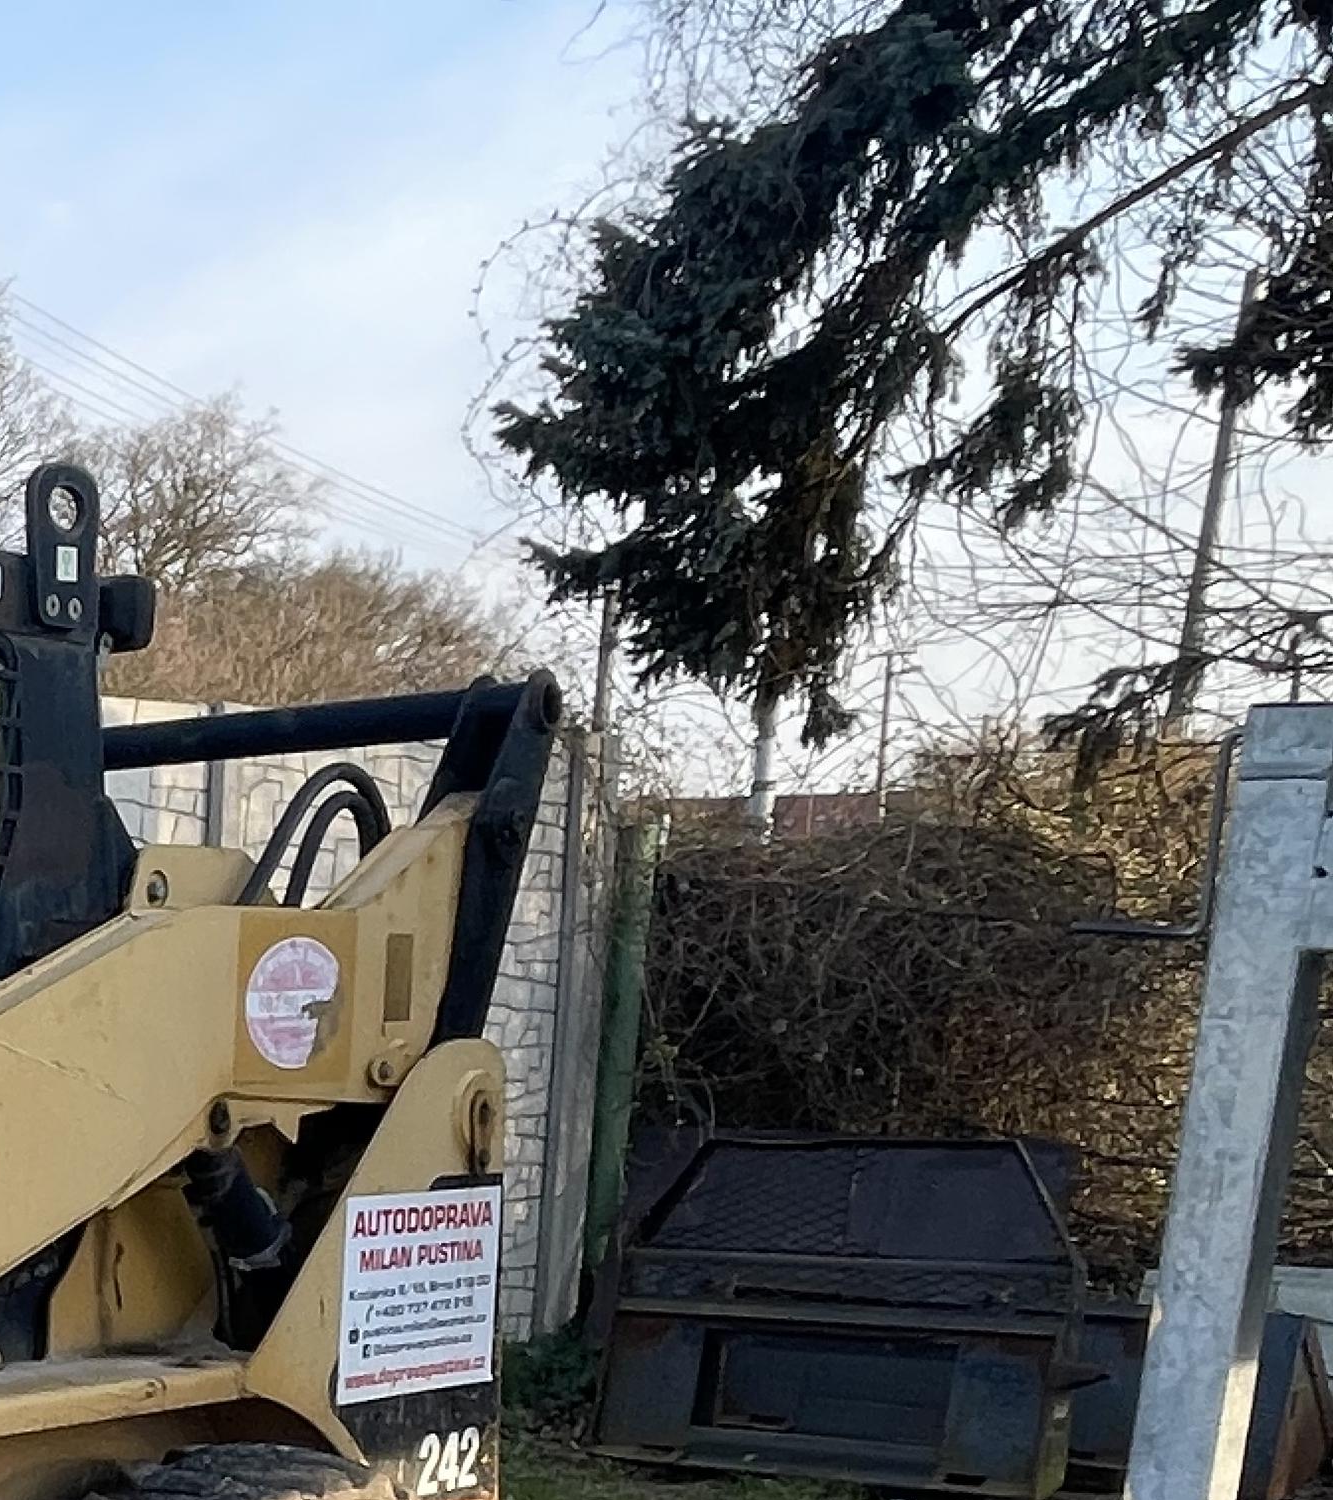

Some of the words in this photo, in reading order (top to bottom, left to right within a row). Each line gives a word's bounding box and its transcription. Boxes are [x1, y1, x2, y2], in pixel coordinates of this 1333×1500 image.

[352, 1200, 493, 1239] AUTODOPRAVA
[359, 1245, 413, 1274] MILAN
[417, 1238, 484, 1268] PUSTINA
[416, 1427, 480, 1496] 242
